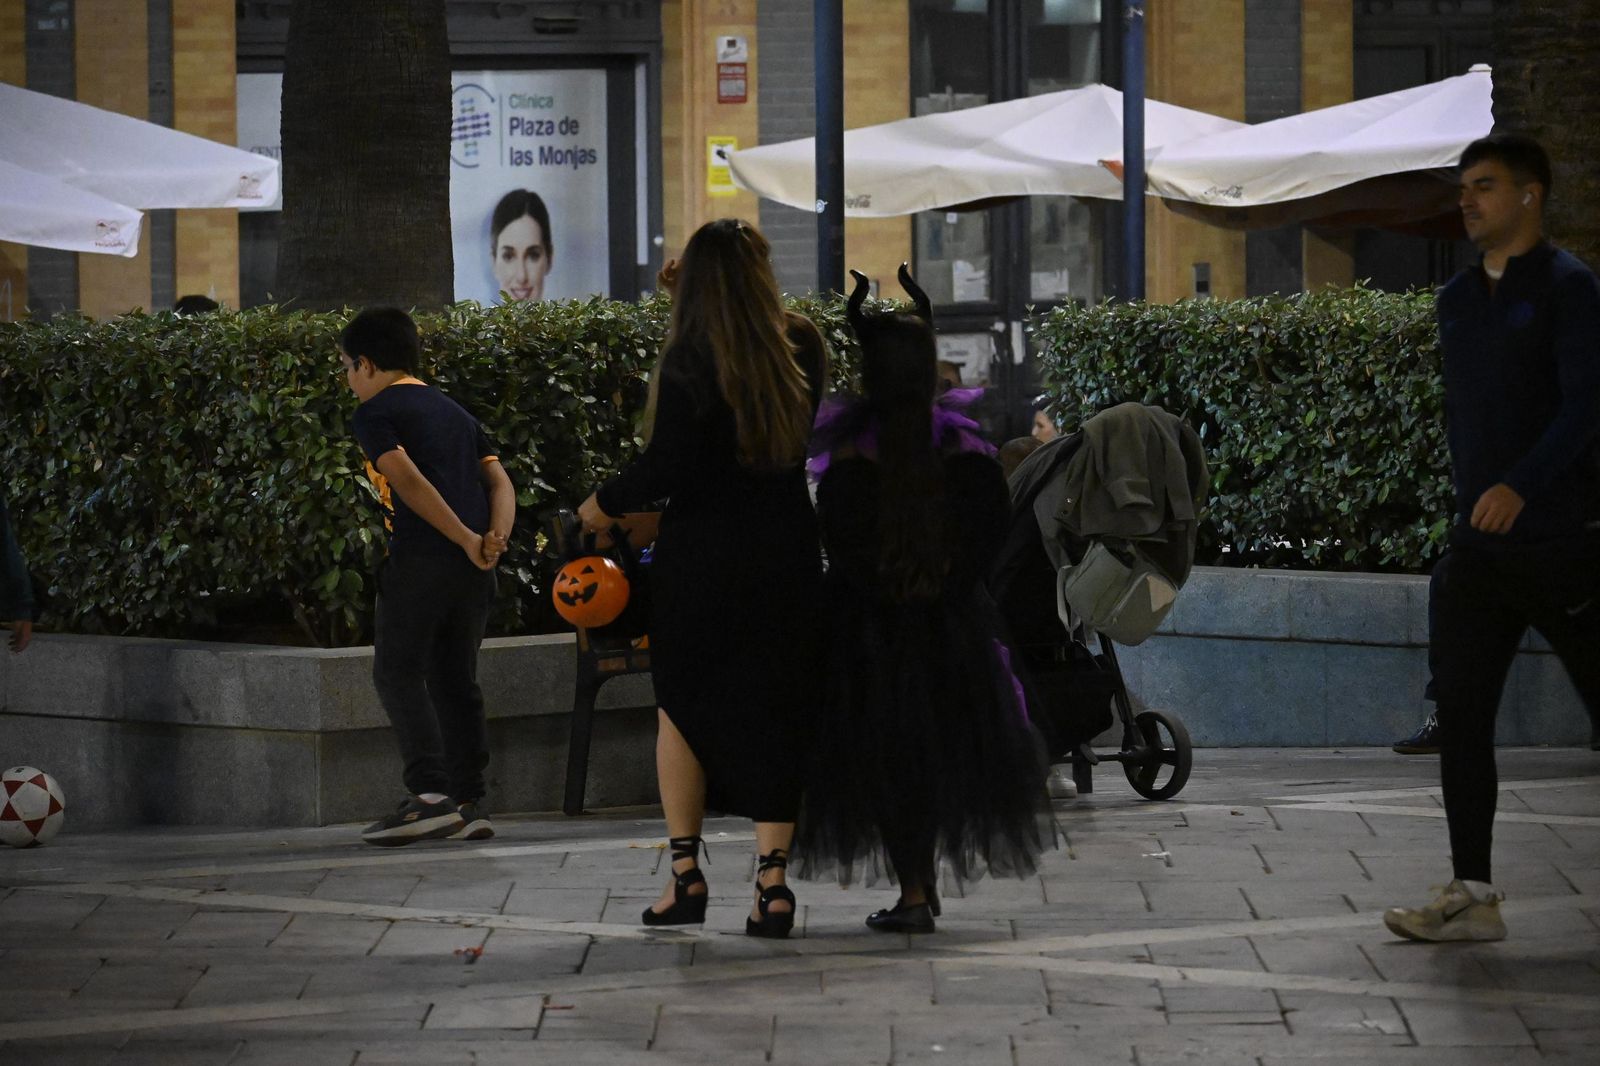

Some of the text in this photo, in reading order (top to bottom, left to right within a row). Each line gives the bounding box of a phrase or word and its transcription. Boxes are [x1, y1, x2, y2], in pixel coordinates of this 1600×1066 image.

[509, 115, 580, 136] Plaza de
[509, 145, 598, 171] las Monjas
